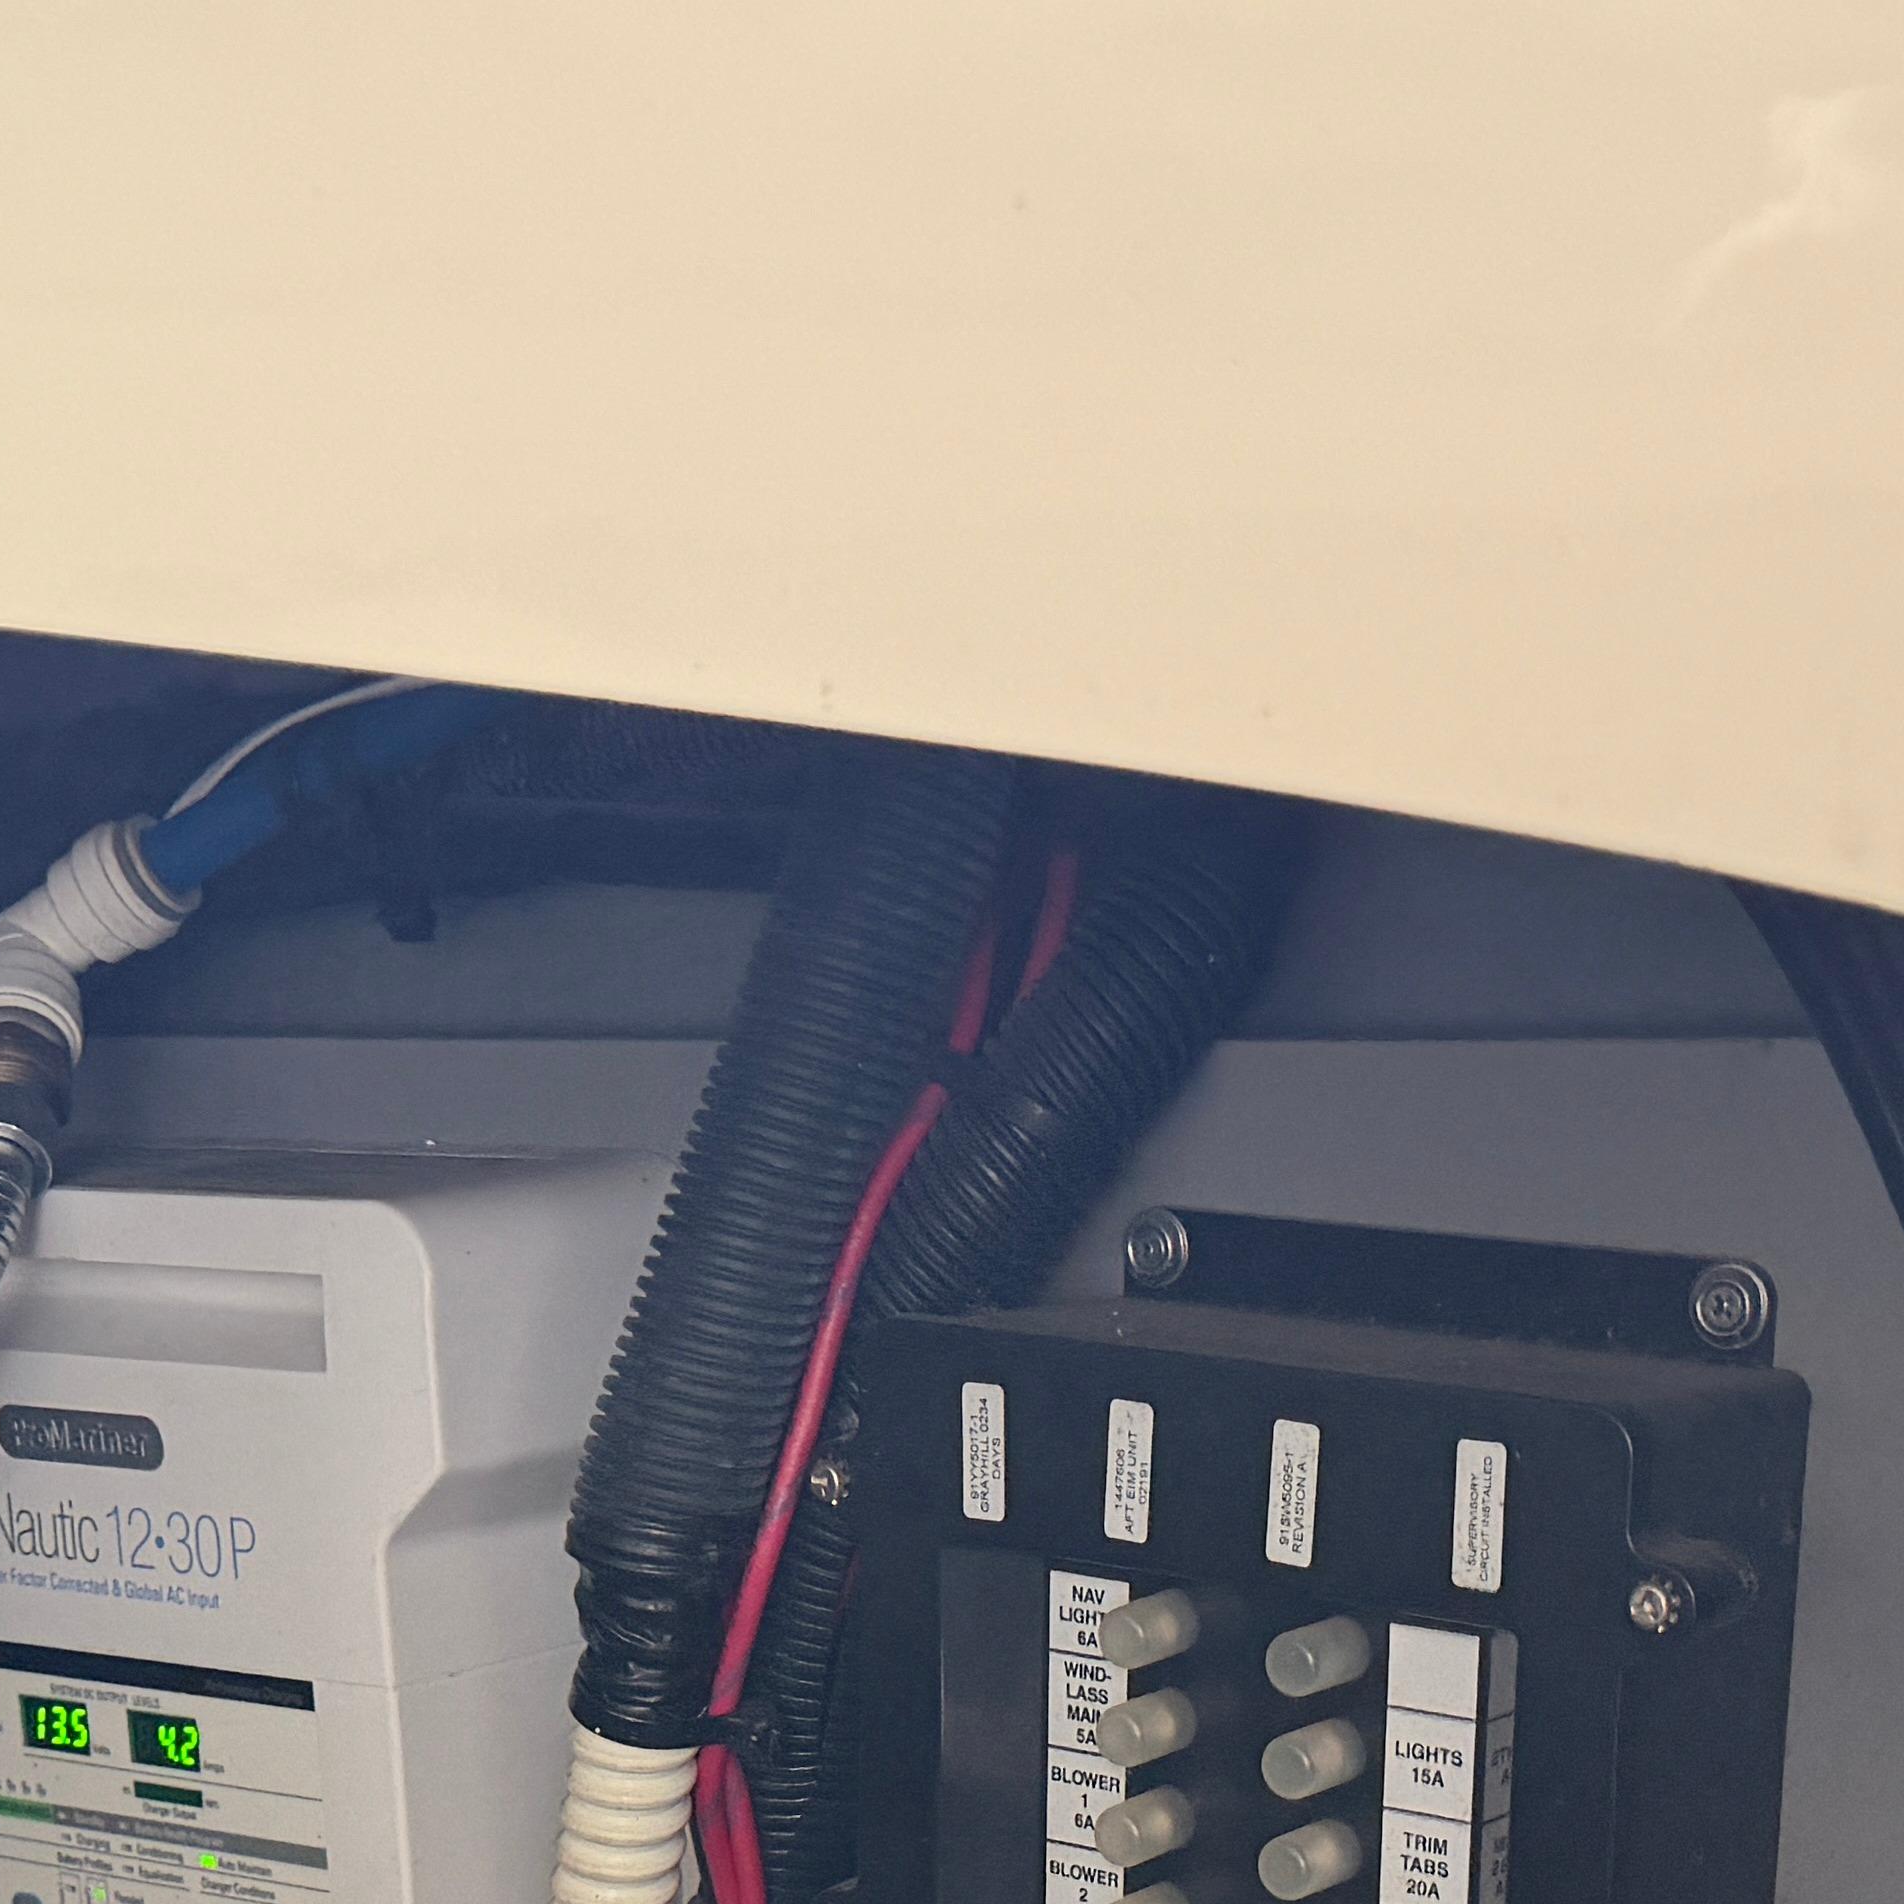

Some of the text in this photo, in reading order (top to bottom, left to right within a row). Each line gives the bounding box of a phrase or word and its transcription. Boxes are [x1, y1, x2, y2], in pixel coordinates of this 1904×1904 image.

[979, 1397, 991, 1513] GRAYHILL 0234
[1124, 1430, 1138, 1535] AFT EIM UNIT
[1291, 1461, 1307, 1554] REVISION A
[1467, 1472, 1479, 1566] SUPERVISORY
[1479, 1456, 1494, 1582] CIRCUIT INSTALLED
[10, 1566, 47, 1588] Factor
[50, 1571, 110, 1597] Corrected
[112, 1580, 123, 1598] &
[124, 1580, 164, 1603] Global
[166, 1585, 185, 1606] AC
[187, 1588, 221, 1610] Input
[1072, 1585, 1105, 1606] NAV
[1059, 1605, 1105, 1627] LIGHT
[1077, 1630, 1098, 1648] 6A
[1064, 1660, 1112, 1682] WIND-
[1066, 1683, 1110, 1705] LASS
[36, 1706, 88, 1748] 13.5
[1076, 1727, 1097, 1746] 5A
[157, 1724, 199, 1766] 4.2
[1395, 1740, 1464, 1768] LIGHTS
[1051, 1765, 1121, 1794] BLOWER
[1411, 1766, 1445, 1789] 15A
[1080, 1793, 1089, 1809] 1
[1074, 1813, 1095, 1831] 6A
[1403, 1831, 1449, 1857] TRIM
[1049, 1860, 1120, 1888] BLOWER
[1399, 1854, 1450, 1878] TABS
[1079, 1887, 1089, 1903] 2
[1406, 1878, 1441, 1901] 20A
